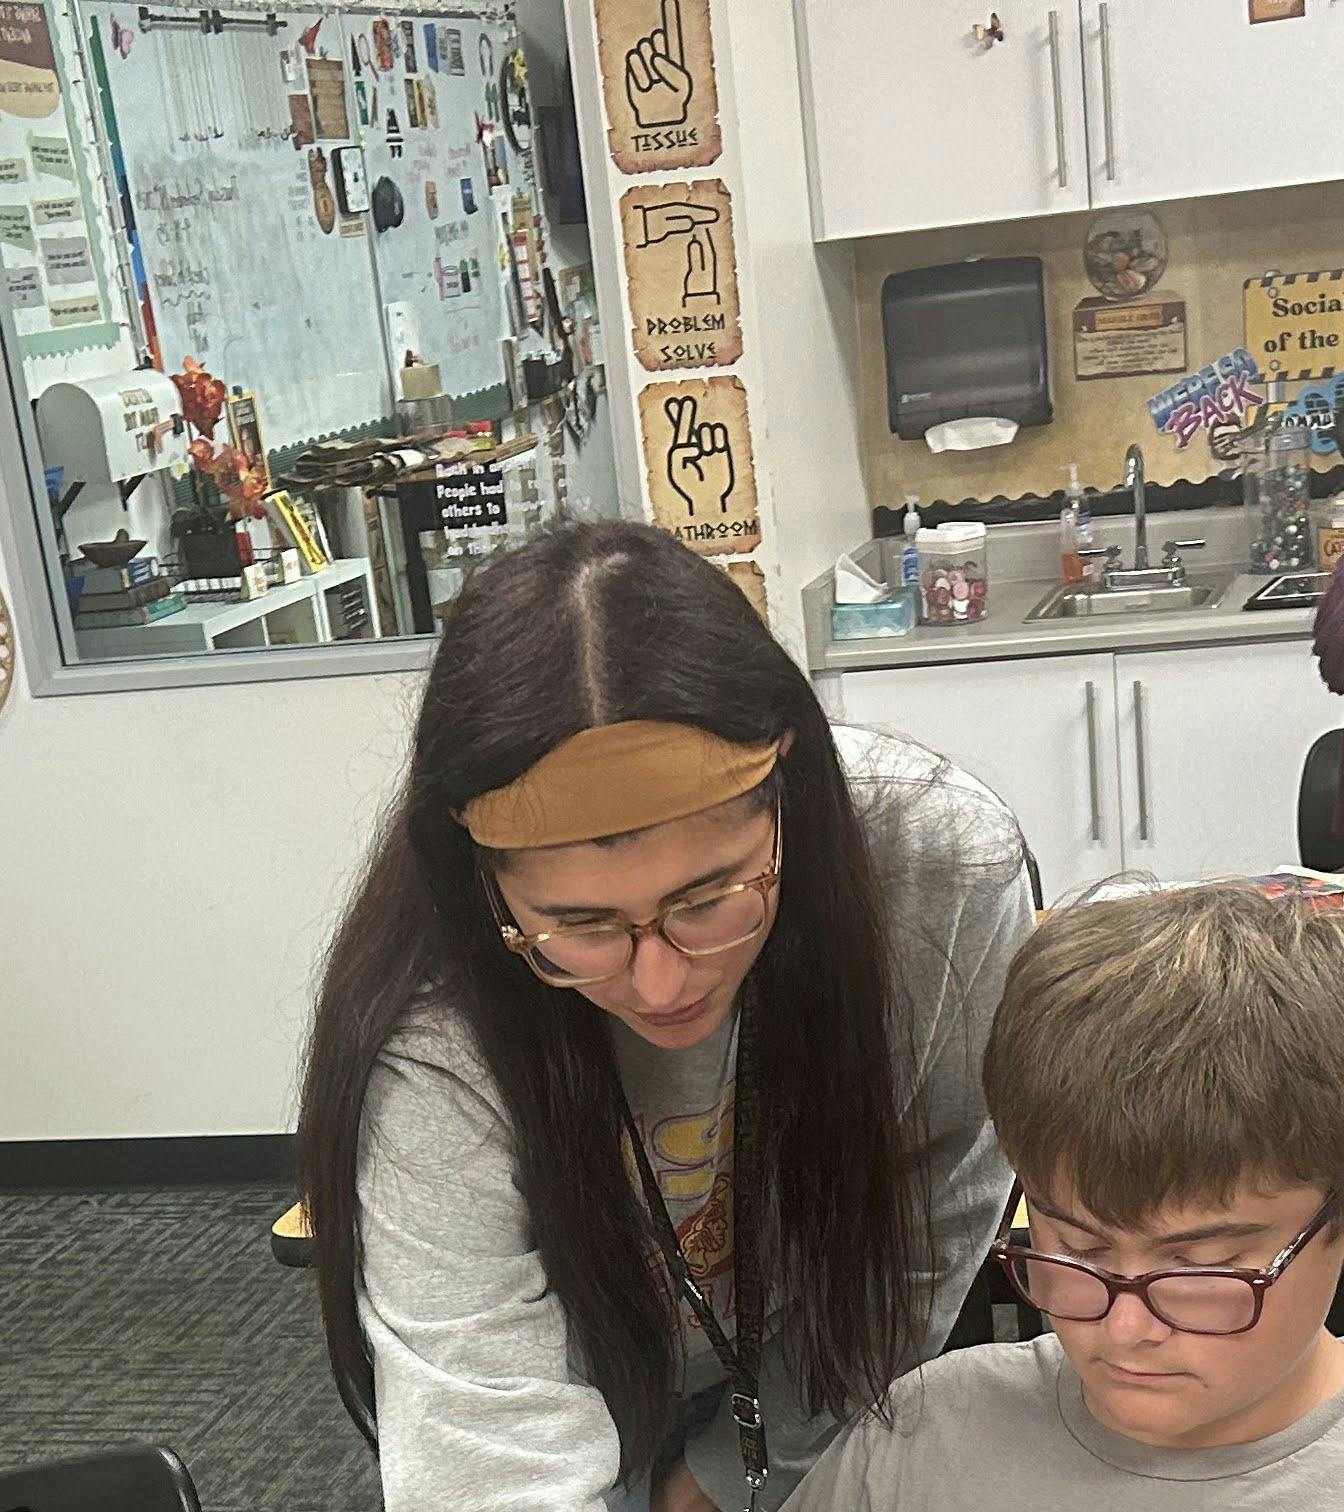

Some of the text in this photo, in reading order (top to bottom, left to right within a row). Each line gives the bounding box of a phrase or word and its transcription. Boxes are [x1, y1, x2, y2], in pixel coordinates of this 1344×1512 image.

[631, 128, 699, 152] TISSUE
[646, 313, 726, 336] PROBLEM
[1263, 331, 1292, 354] of
[1298, 327, 1339, 350] the
[661, 342, 718, 364] SOLVE
[1164, 370, 1264, 448] BACK
[436, 483, 477, 501] People
[442, 503, 483, 519] others
[486, 502, 501, 515] to
[669, 519, 758, 541] ATHROOM
